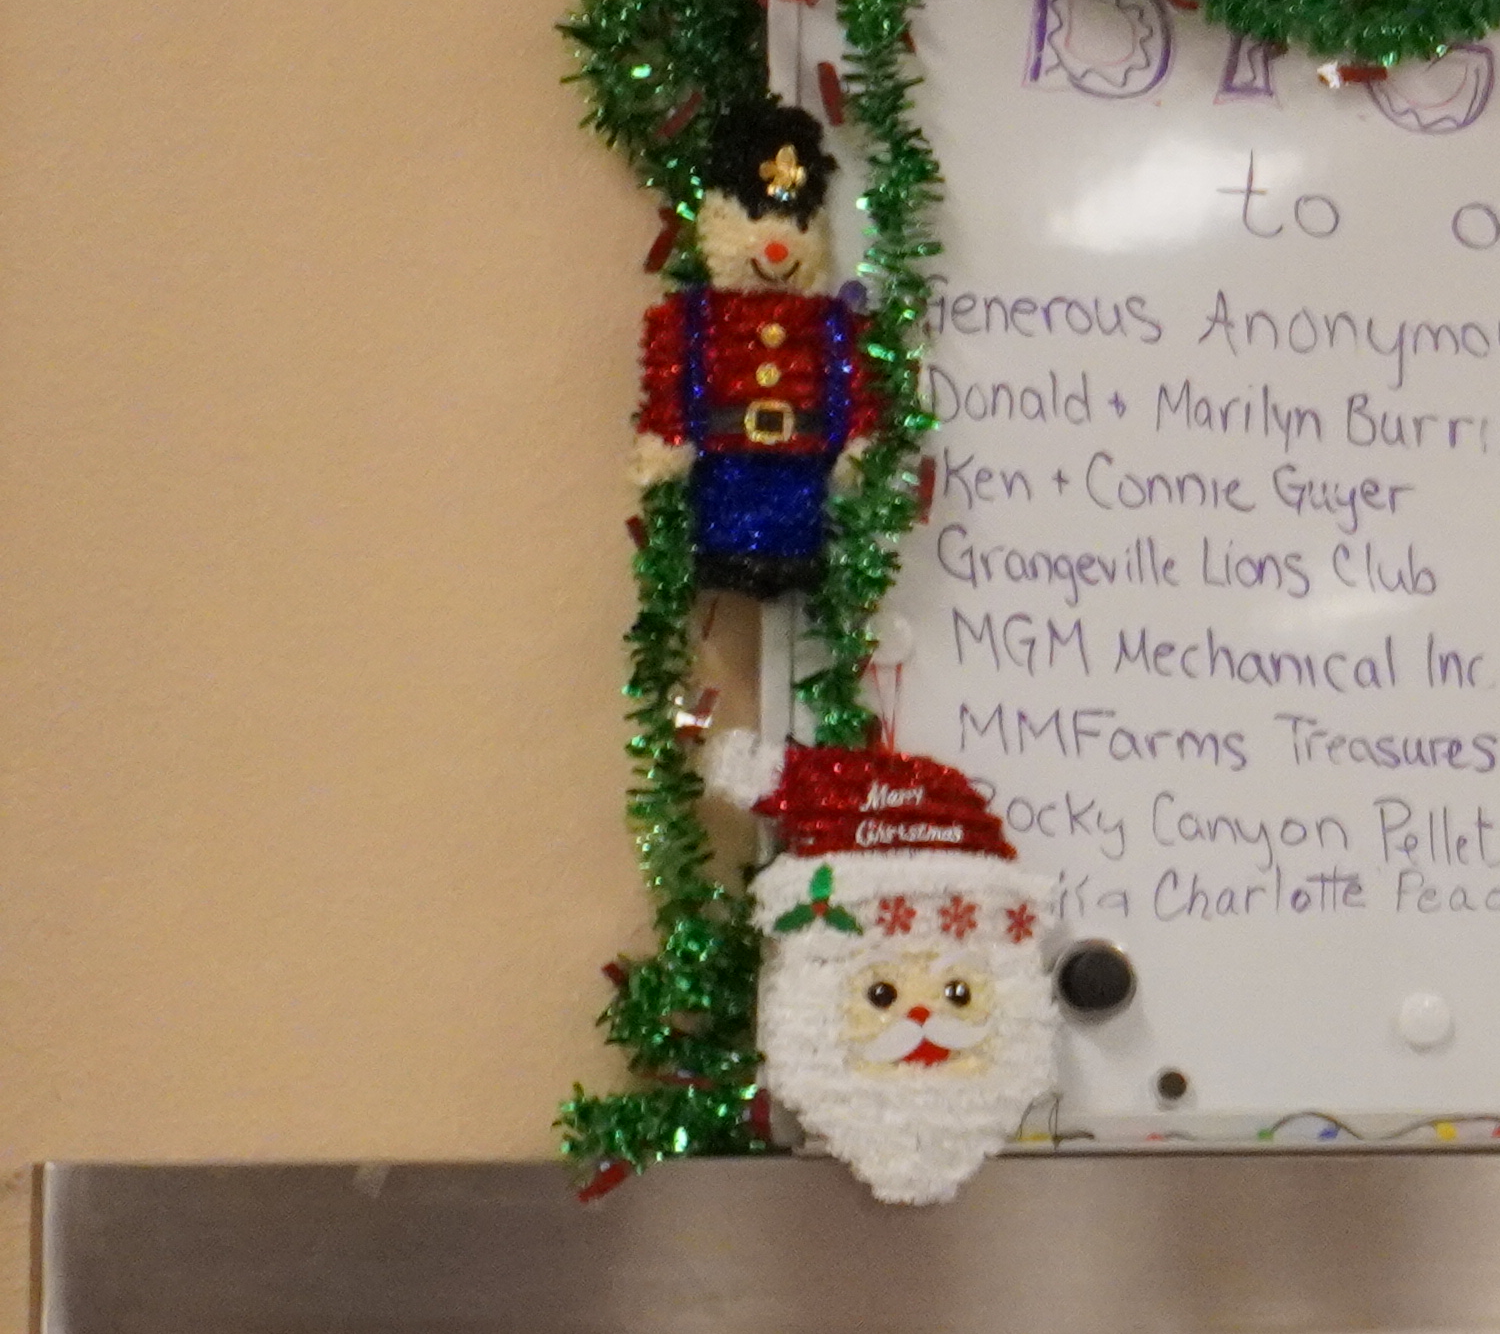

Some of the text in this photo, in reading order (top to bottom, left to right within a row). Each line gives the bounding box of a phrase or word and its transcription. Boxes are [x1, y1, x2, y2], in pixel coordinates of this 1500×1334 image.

[1217, 149, 1339, 239] to
[927, 364, 1092, 425] Donald
[1156, 378, 1323, 453] Marilyn
[942, 446, 1033, 510] Ken
[1085, 450, 1257, 512] Connie
[936, 522, 1437, 609] Grangeville Lions Club
[952, 605, 1091, 678] MGM
[1113, 625, 1397, 694] Mechanical
[1273, 712, 1498, 773] Treasures
[1152, 789, 1349, 873] Canyon
[1153, 864, 1366, 921] Charlotte
